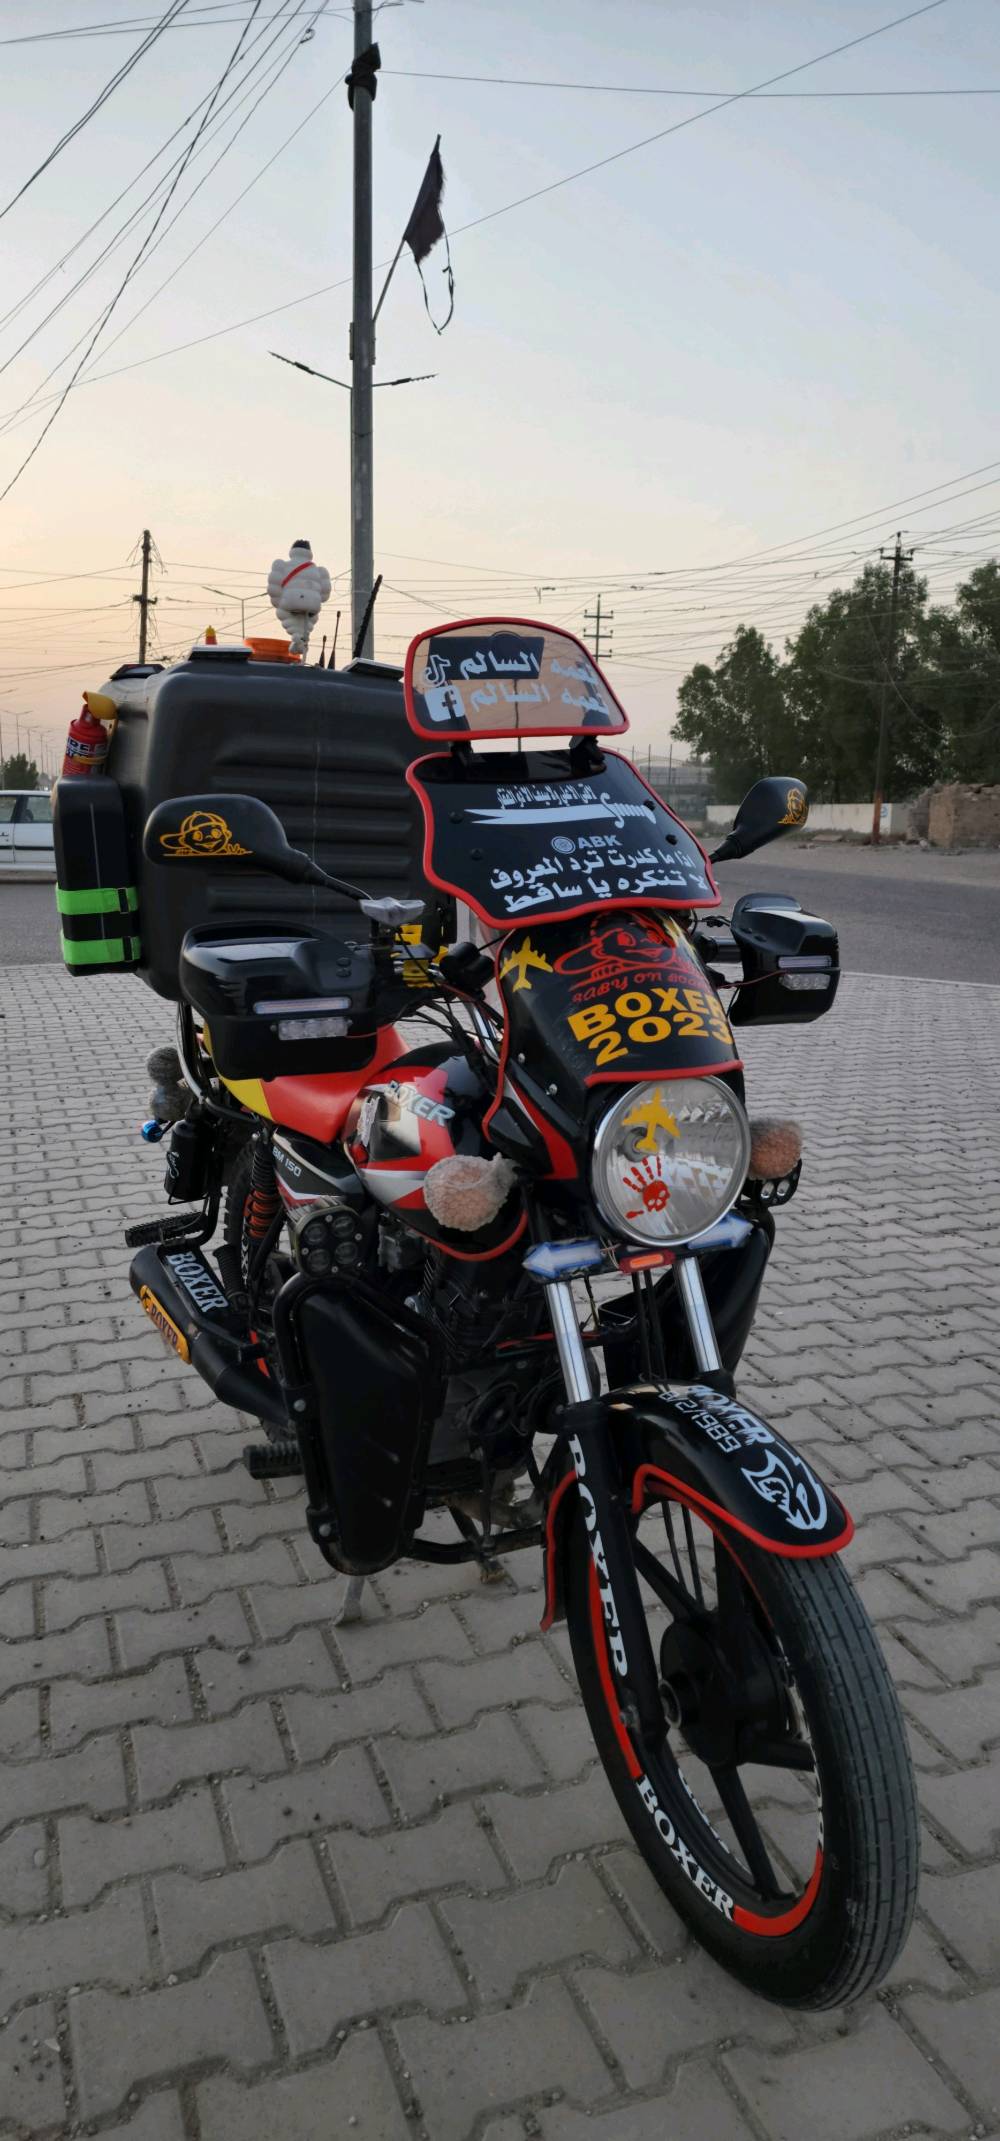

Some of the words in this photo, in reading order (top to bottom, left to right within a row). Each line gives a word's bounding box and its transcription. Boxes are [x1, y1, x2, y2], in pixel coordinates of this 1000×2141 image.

[576, 834, 623, 849] ABK
[568, 850, 605, 874] ترد
[658, 849, 676, 865] ما
[490, 856, 564, 889] المعروف
[617, 869, 688, 894] تنكره
[503, 880, 583, 913] ساقط
[587, 877, 612, 898] يا
[567, 987, 730, 1042] BOXER
[588, 1011, 735, 1066] 2023
[285, 1158, 301, 1177] 150
[165, 1250, 230, 1314] BOXER
[636, 1774, 734, 1921] BOXER
